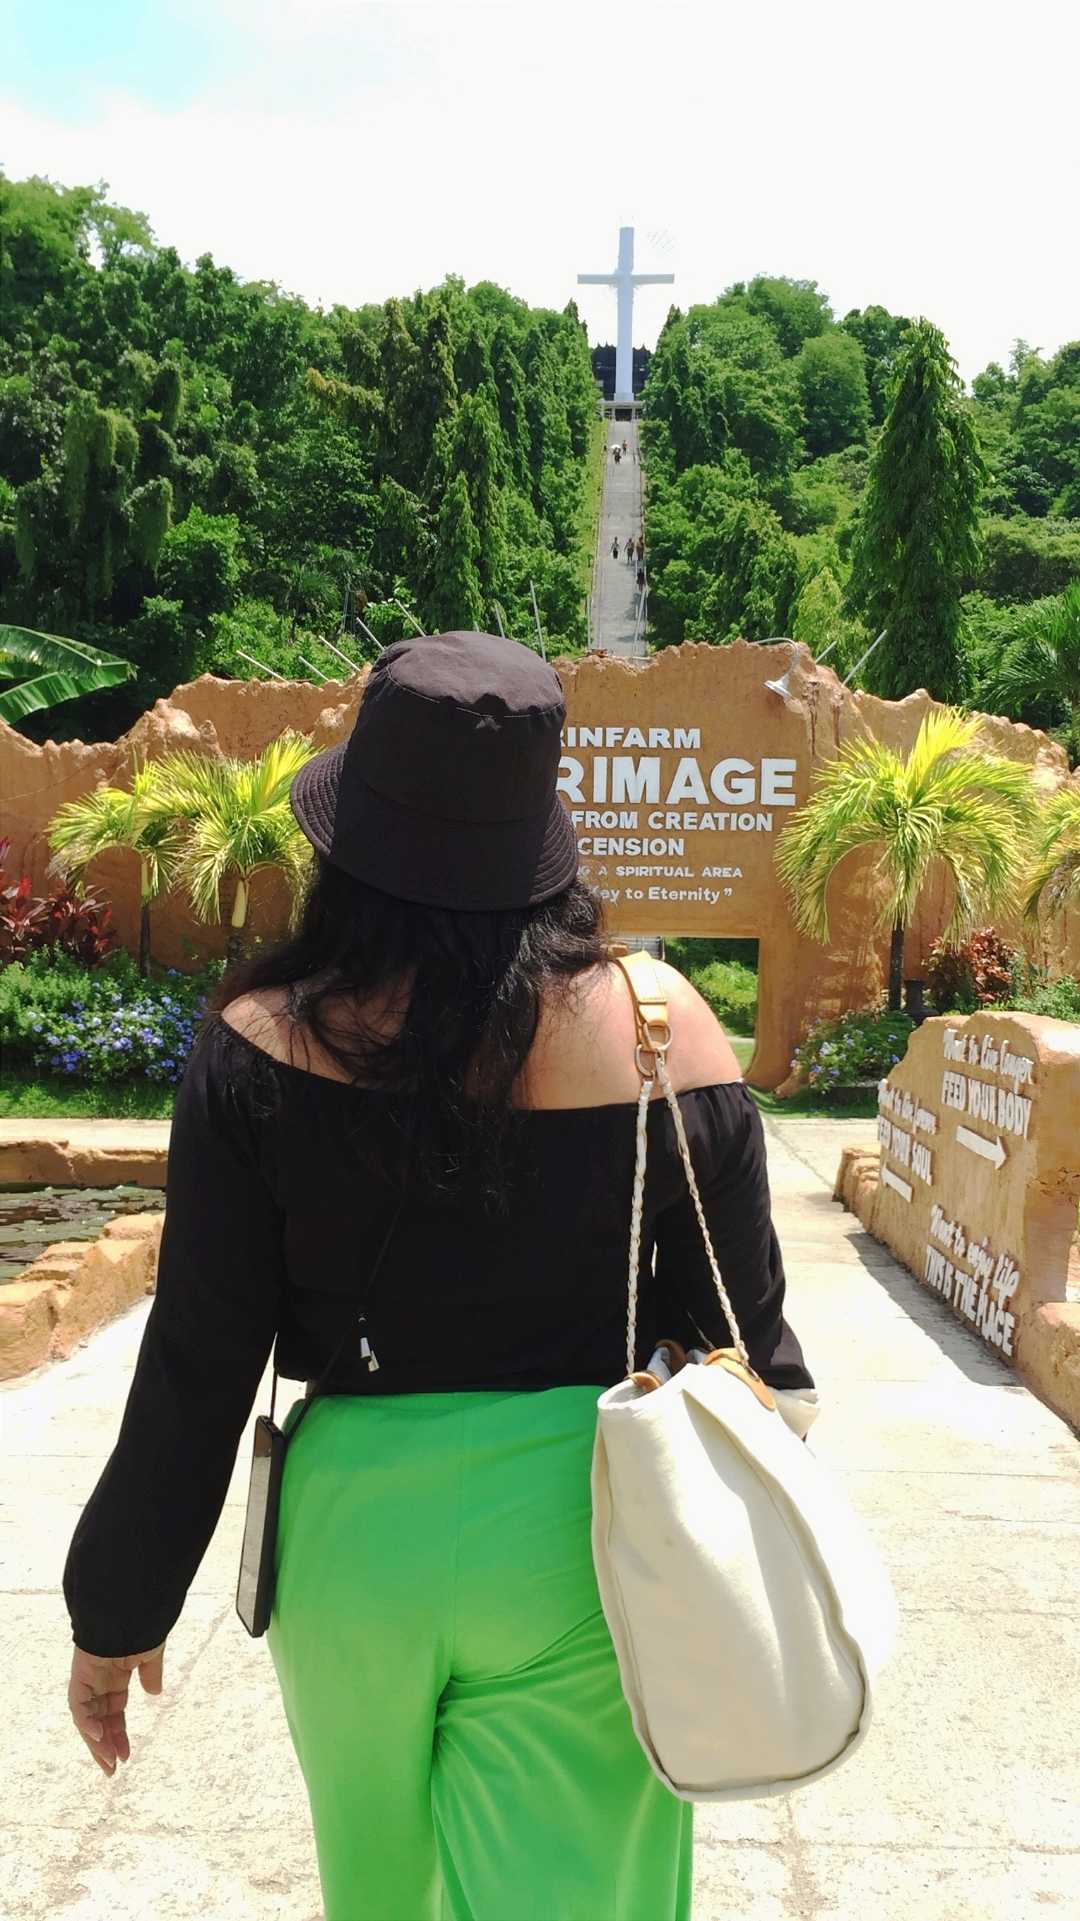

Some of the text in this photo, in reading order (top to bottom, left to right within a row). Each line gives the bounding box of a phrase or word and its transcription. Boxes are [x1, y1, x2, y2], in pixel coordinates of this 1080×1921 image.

[556, 756, 797, 806] RIMAGE
[571, 810, 773, 832] FROM CREATION
[577, 837, 684, 856] CENSION
[616, 865, 695, 878] SPIRITUAL
[702, 866, 743, 879] AREA
[625, 887, 644, 900] to
[941, 1070, 1032, 1140] FEED YOUR BODY
[911, 1141, 933, 1186] SOUL
[925, 1244, 1015, 1357] THIS IS THE PLACE
